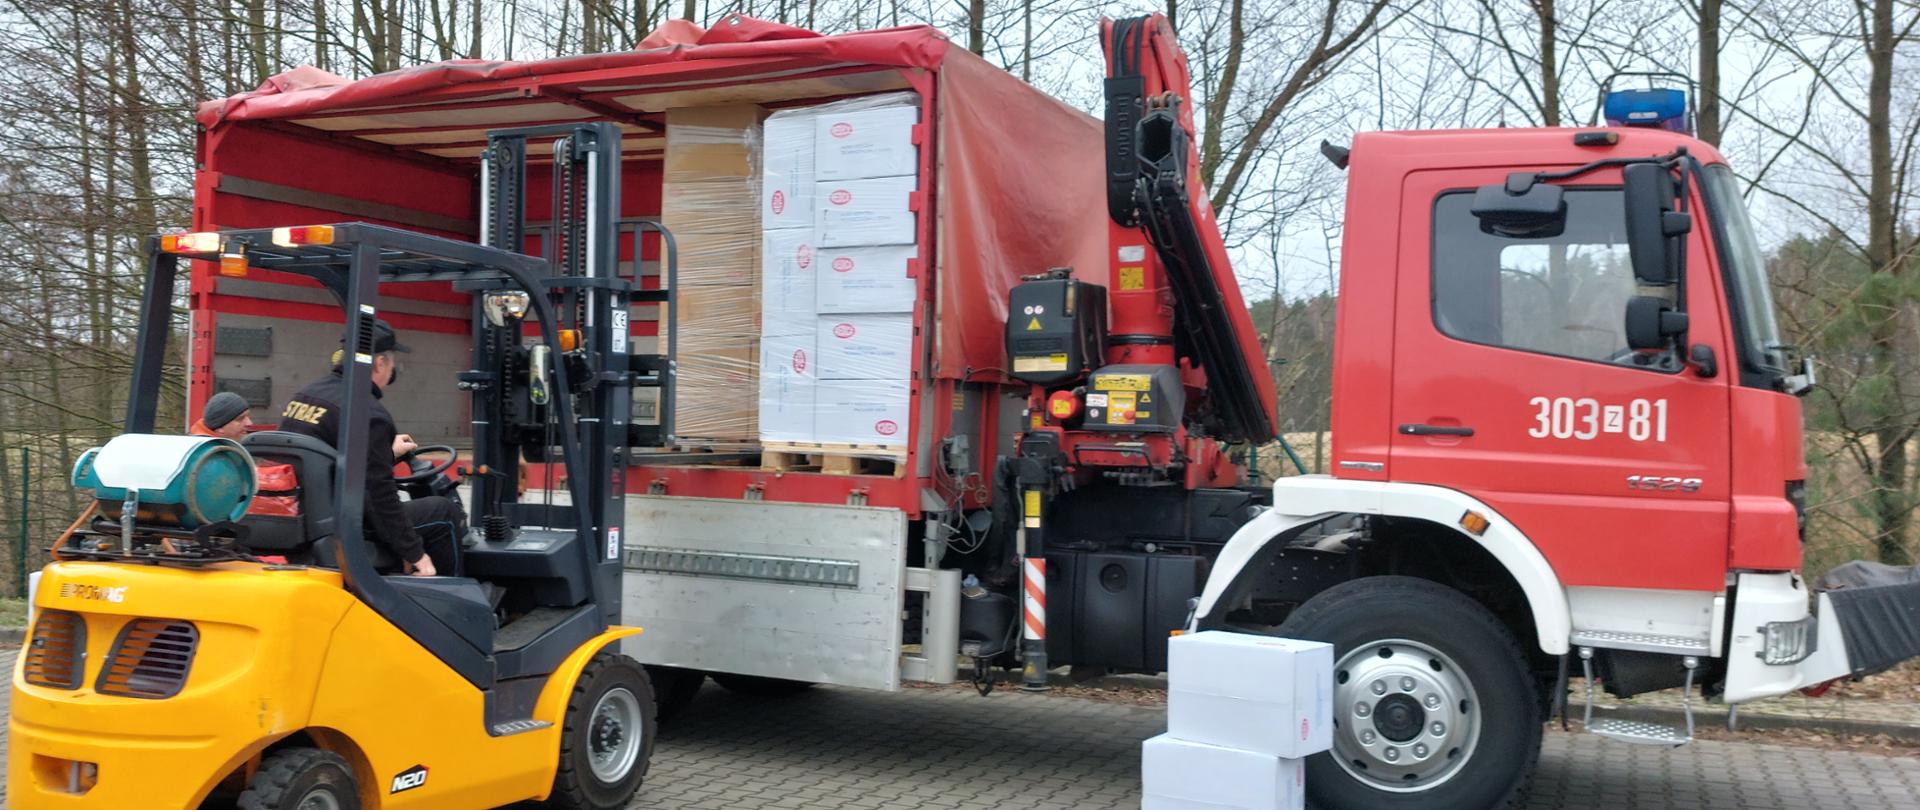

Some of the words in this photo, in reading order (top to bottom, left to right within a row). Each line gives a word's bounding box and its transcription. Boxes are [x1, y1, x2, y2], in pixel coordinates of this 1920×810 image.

[1528, 396, 1600, 441] 303
[1628, 398, 1668, 442] 81
[1626, 475, 1703, 492] 1529
[391, 770, 427, 792] N20
